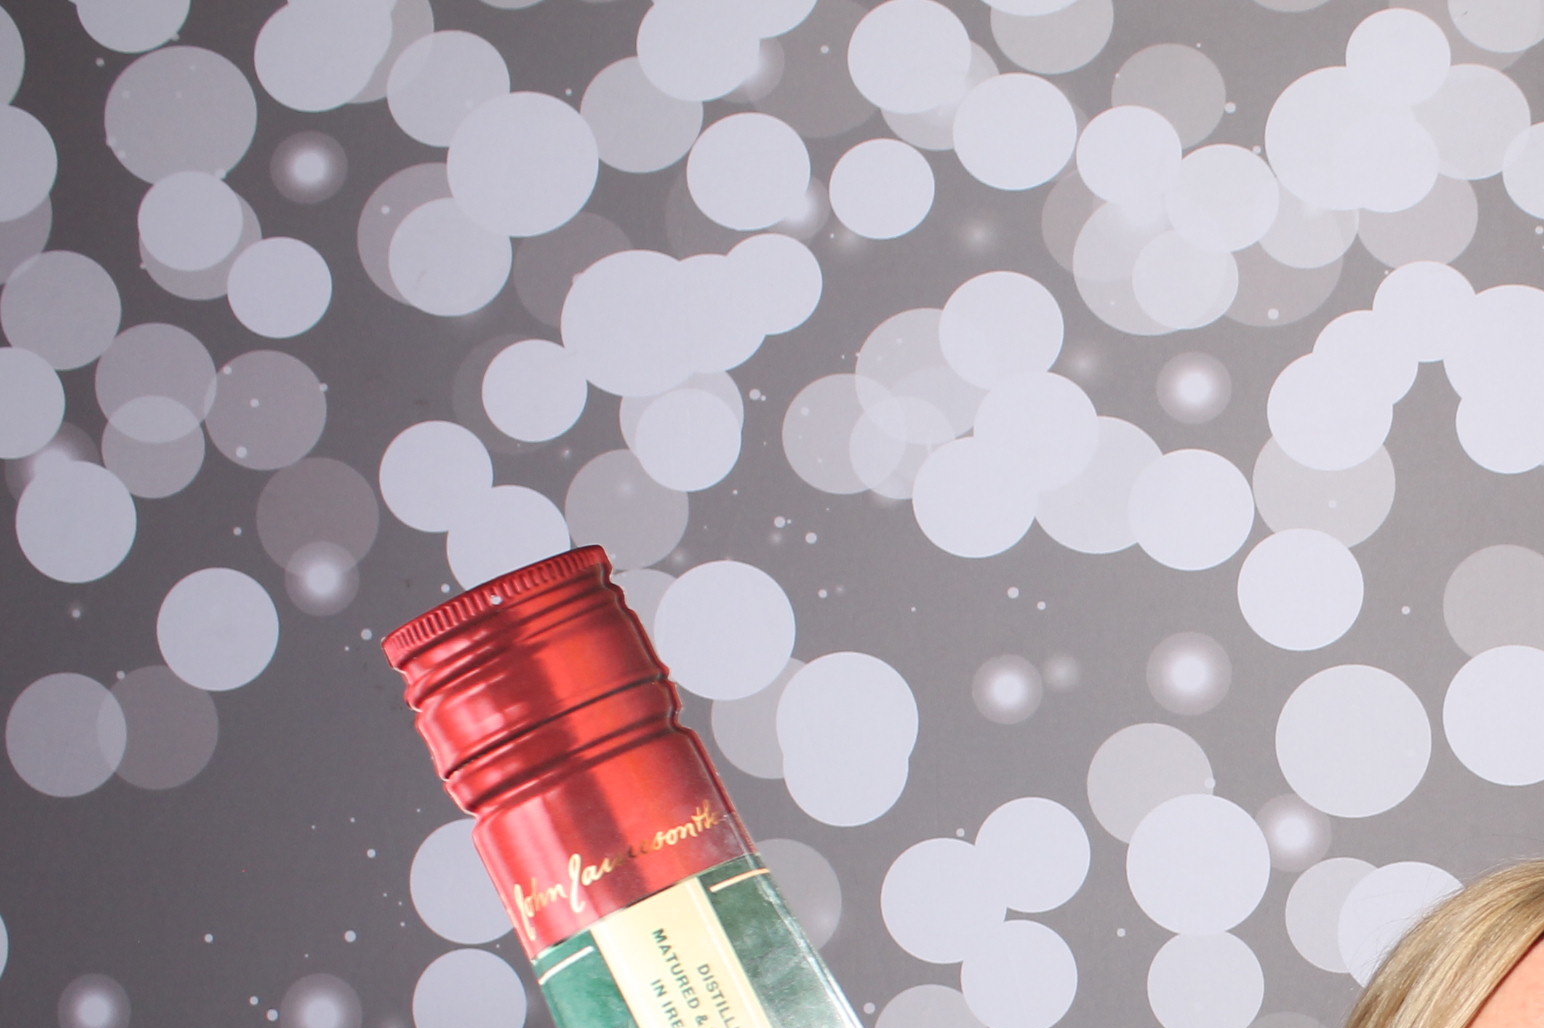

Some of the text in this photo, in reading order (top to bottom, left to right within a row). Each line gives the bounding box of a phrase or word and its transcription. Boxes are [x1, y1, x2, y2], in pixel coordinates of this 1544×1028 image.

[650, 978, 667, 998] IN
[652, 927, 700, 1010] MATURED
[695, 1014, 709, 1026] &
